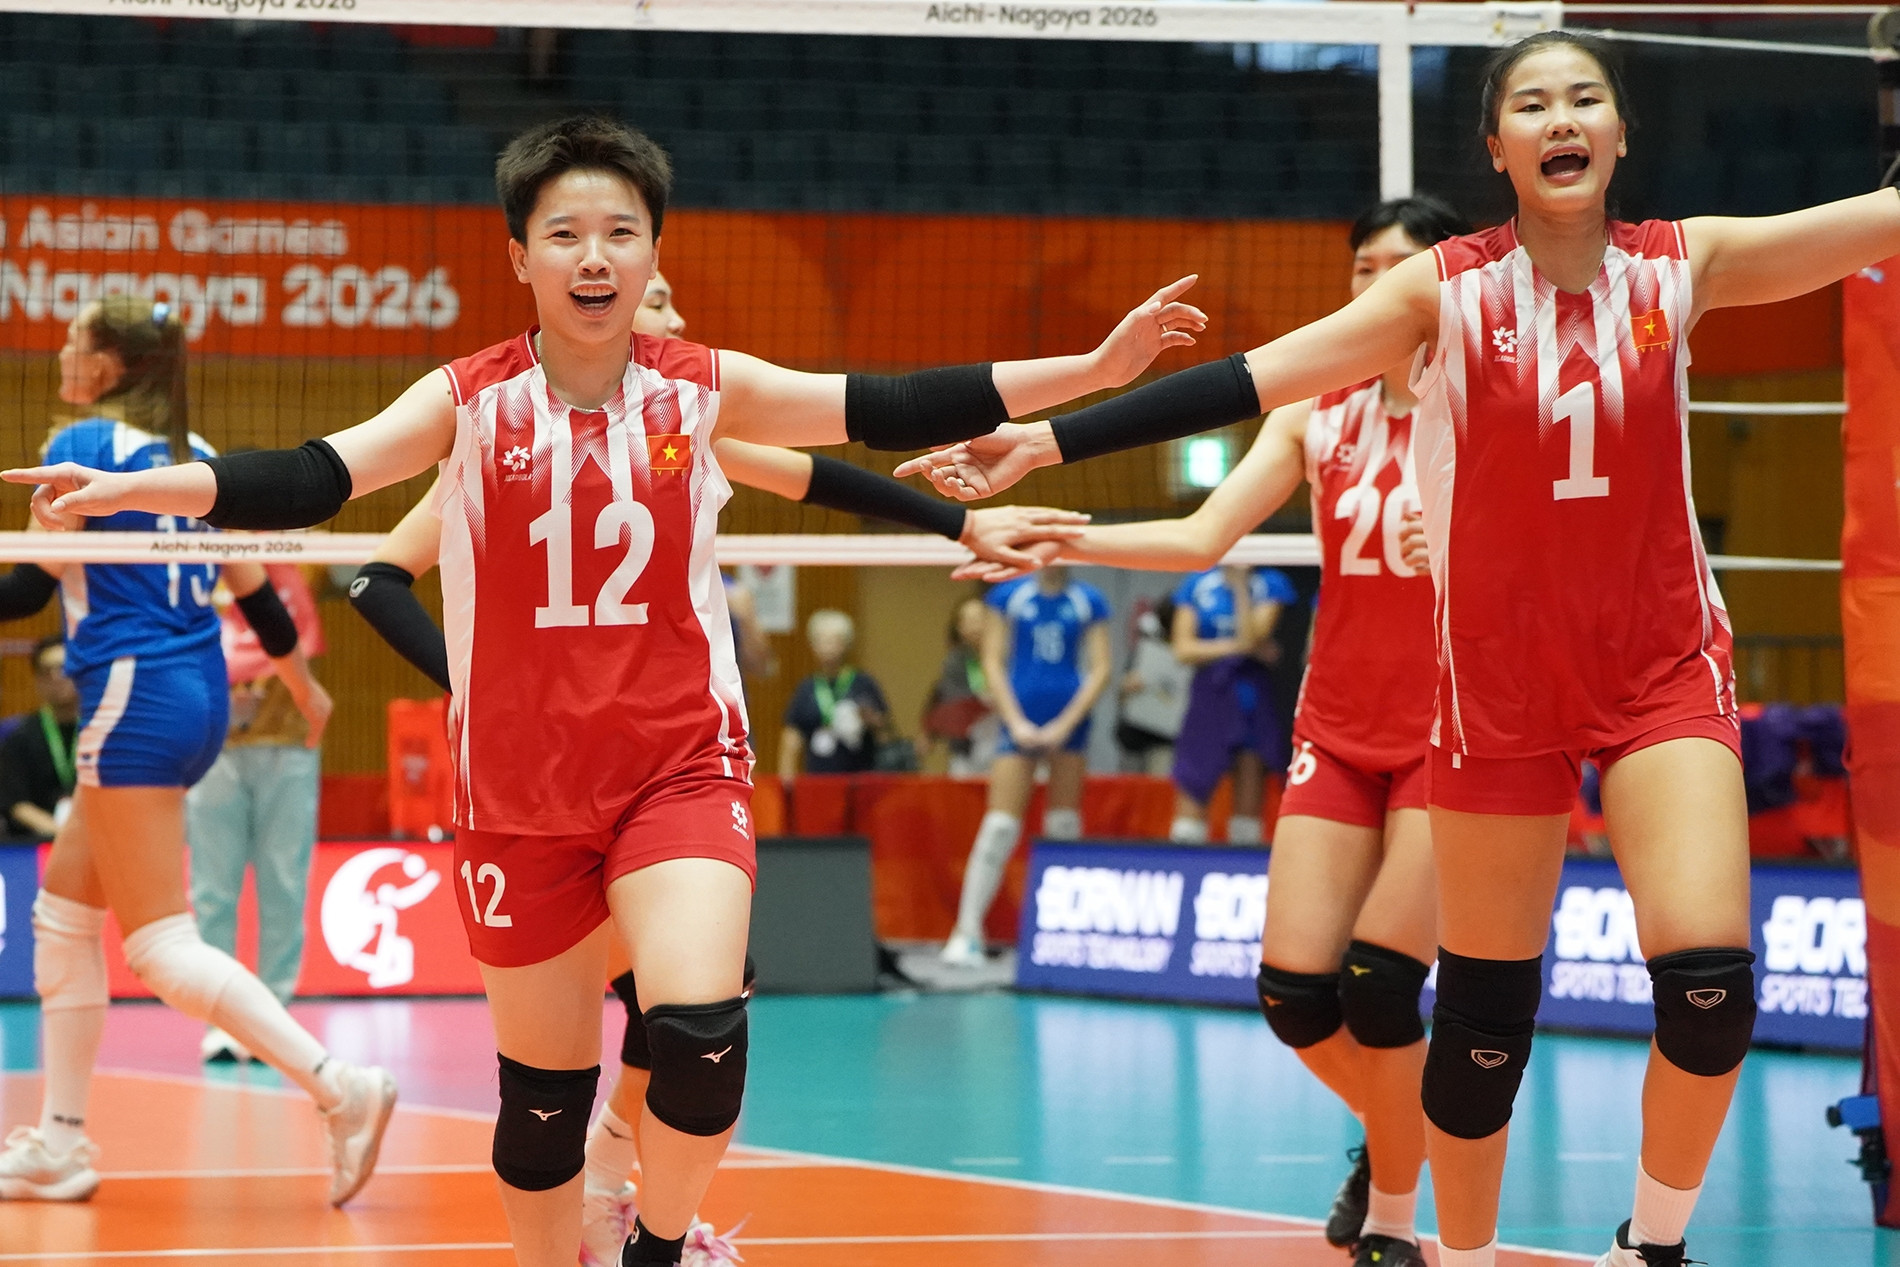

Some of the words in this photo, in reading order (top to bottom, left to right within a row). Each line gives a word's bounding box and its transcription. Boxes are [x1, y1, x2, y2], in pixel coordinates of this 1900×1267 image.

[925, 4, 1090, 30] Aichi-Nagoya
[1099, 7, 1157, 26] 2026
[21, 204, 159, 250] Asian
[169, 209, 348, 255] Games
[282, 265, 459, 328] 2026
[1552, 381, 1609, 500] 1
[151, 541, 260, 558] Aichi-Nagoya
[264, 542, 304, 553] 2026
[528, 500, 655, 628] 12
[460, 860, 513, 928] 12
